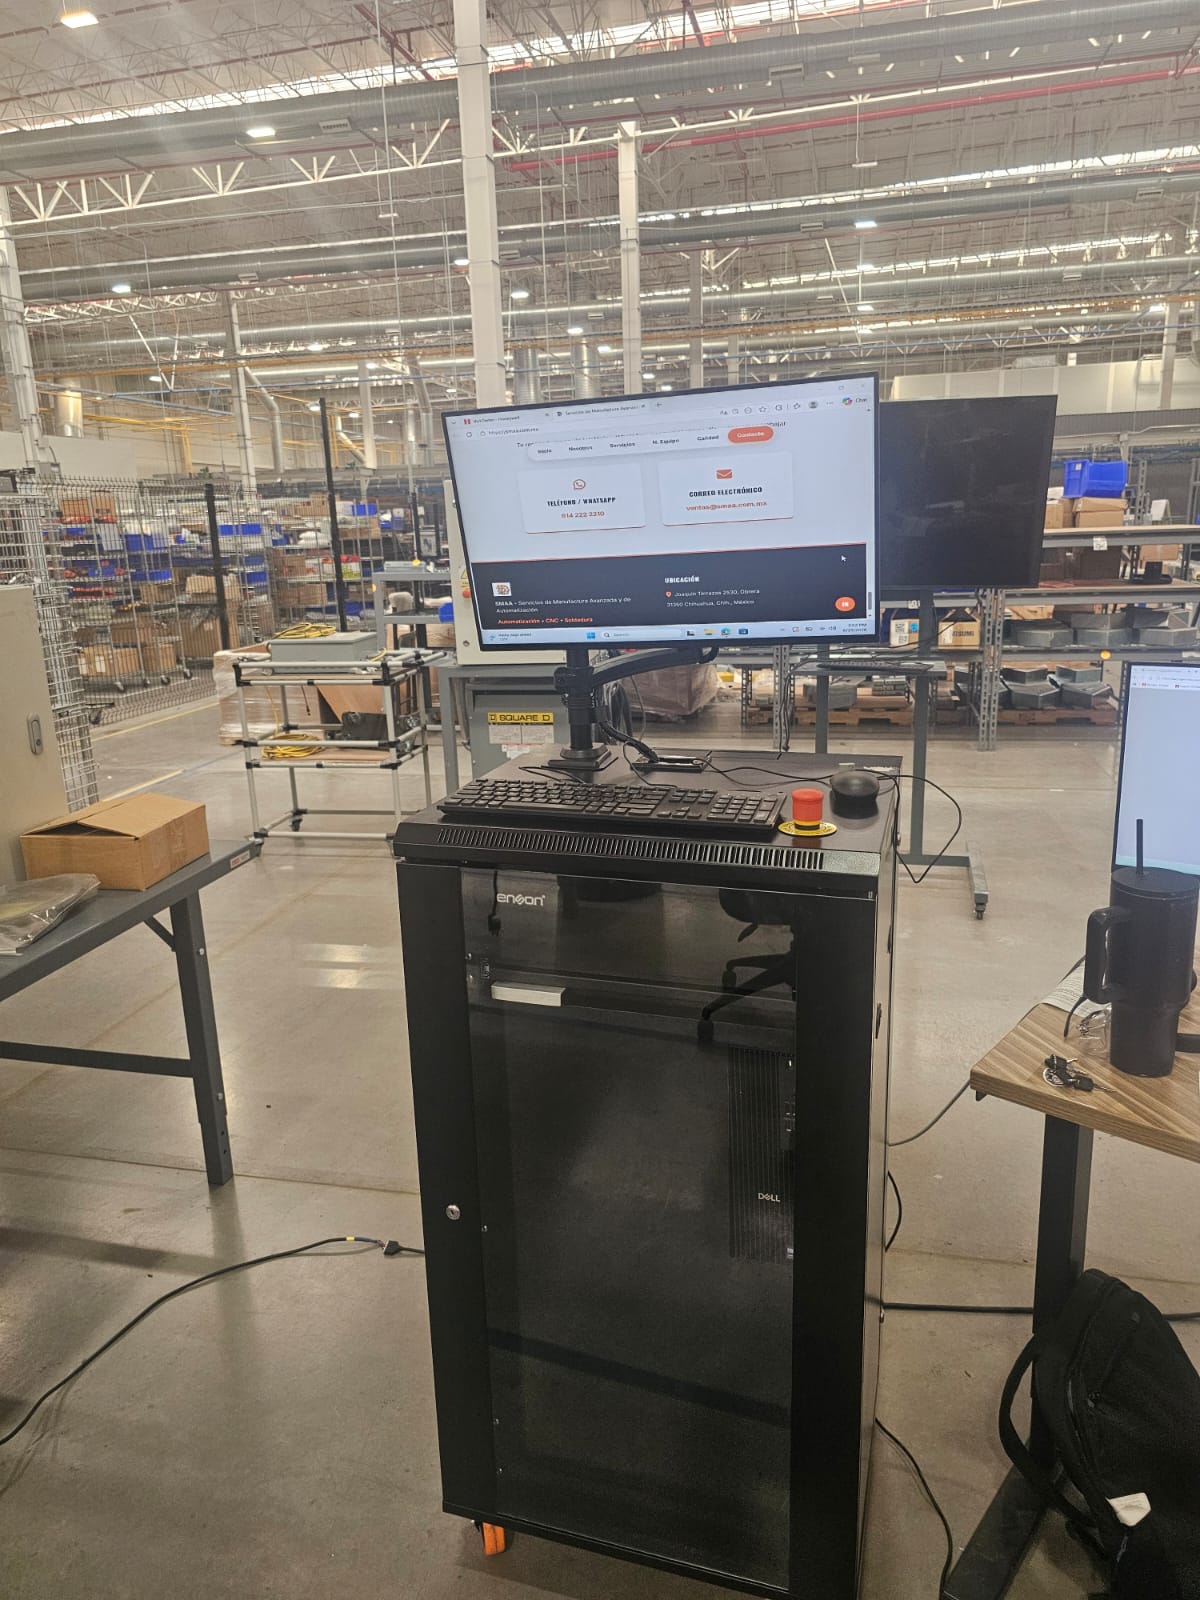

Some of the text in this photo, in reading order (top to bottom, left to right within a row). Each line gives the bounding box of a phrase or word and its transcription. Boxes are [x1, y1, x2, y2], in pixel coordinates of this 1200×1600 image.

[688, 486, 763, 498] CORREO ELECTRÓNICO
[547, 498, 576, 507] TELÉFONO
[582, 496, 616, 505] WHATSAPP
[664, 575, 700, 584] UBICACIÓN
[564, 616, 593, 624] Soldadura
[499, 714, 539, 722] SQUARE
[542, 714, 551, 722] D
[757, 1192, 781, 1203] DELL
